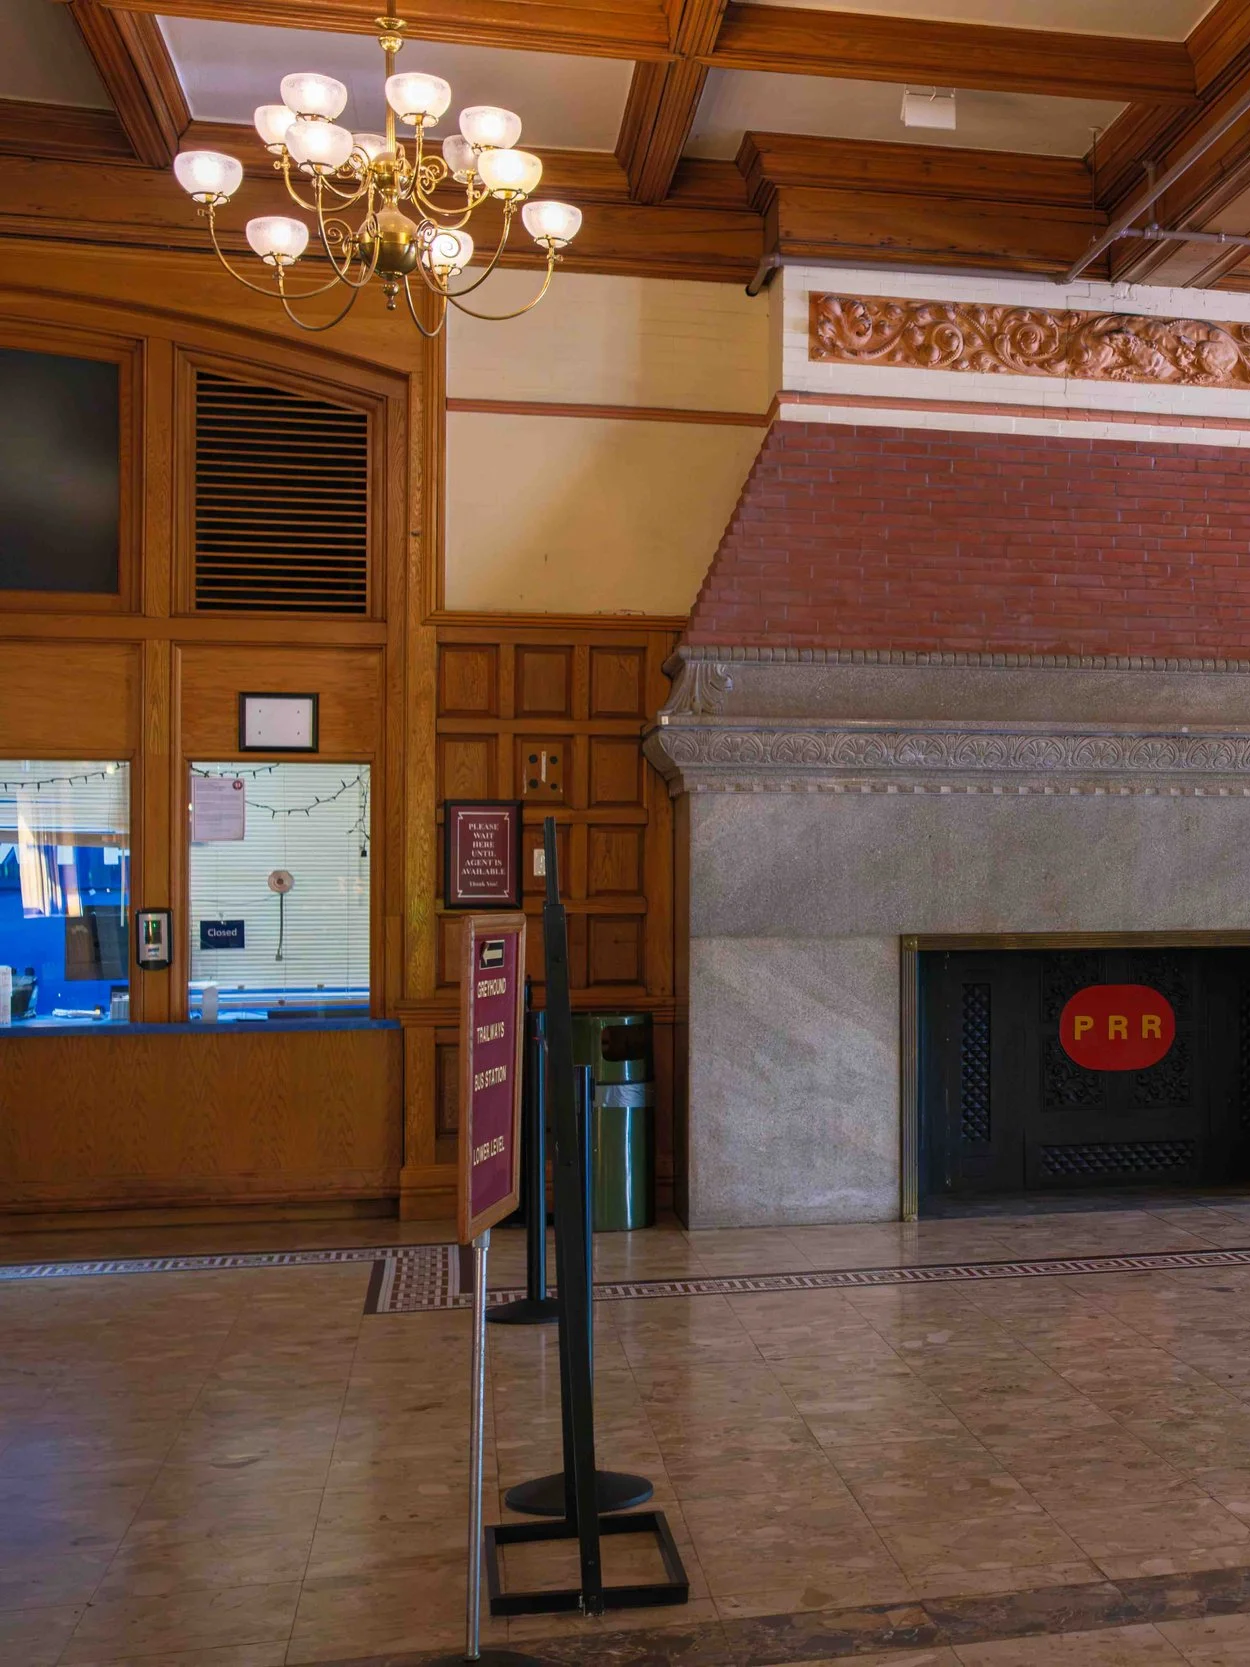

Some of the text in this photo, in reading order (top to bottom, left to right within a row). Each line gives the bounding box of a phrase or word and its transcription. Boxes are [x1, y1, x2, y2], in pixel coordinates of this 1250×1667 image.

[468, 823, 499, 831] PLEASE
[472, 841, 495, 849] HERE
[207, 928, 238, 937] Closed
[477, 977, 506, 999] GREYHOUND
[476, 1021, 505, 1045] TRAILWAYS
[474, 1065, 507, 1092] BUS STATION
[473, 1135, 505, 1166] LOWER LEVEL
